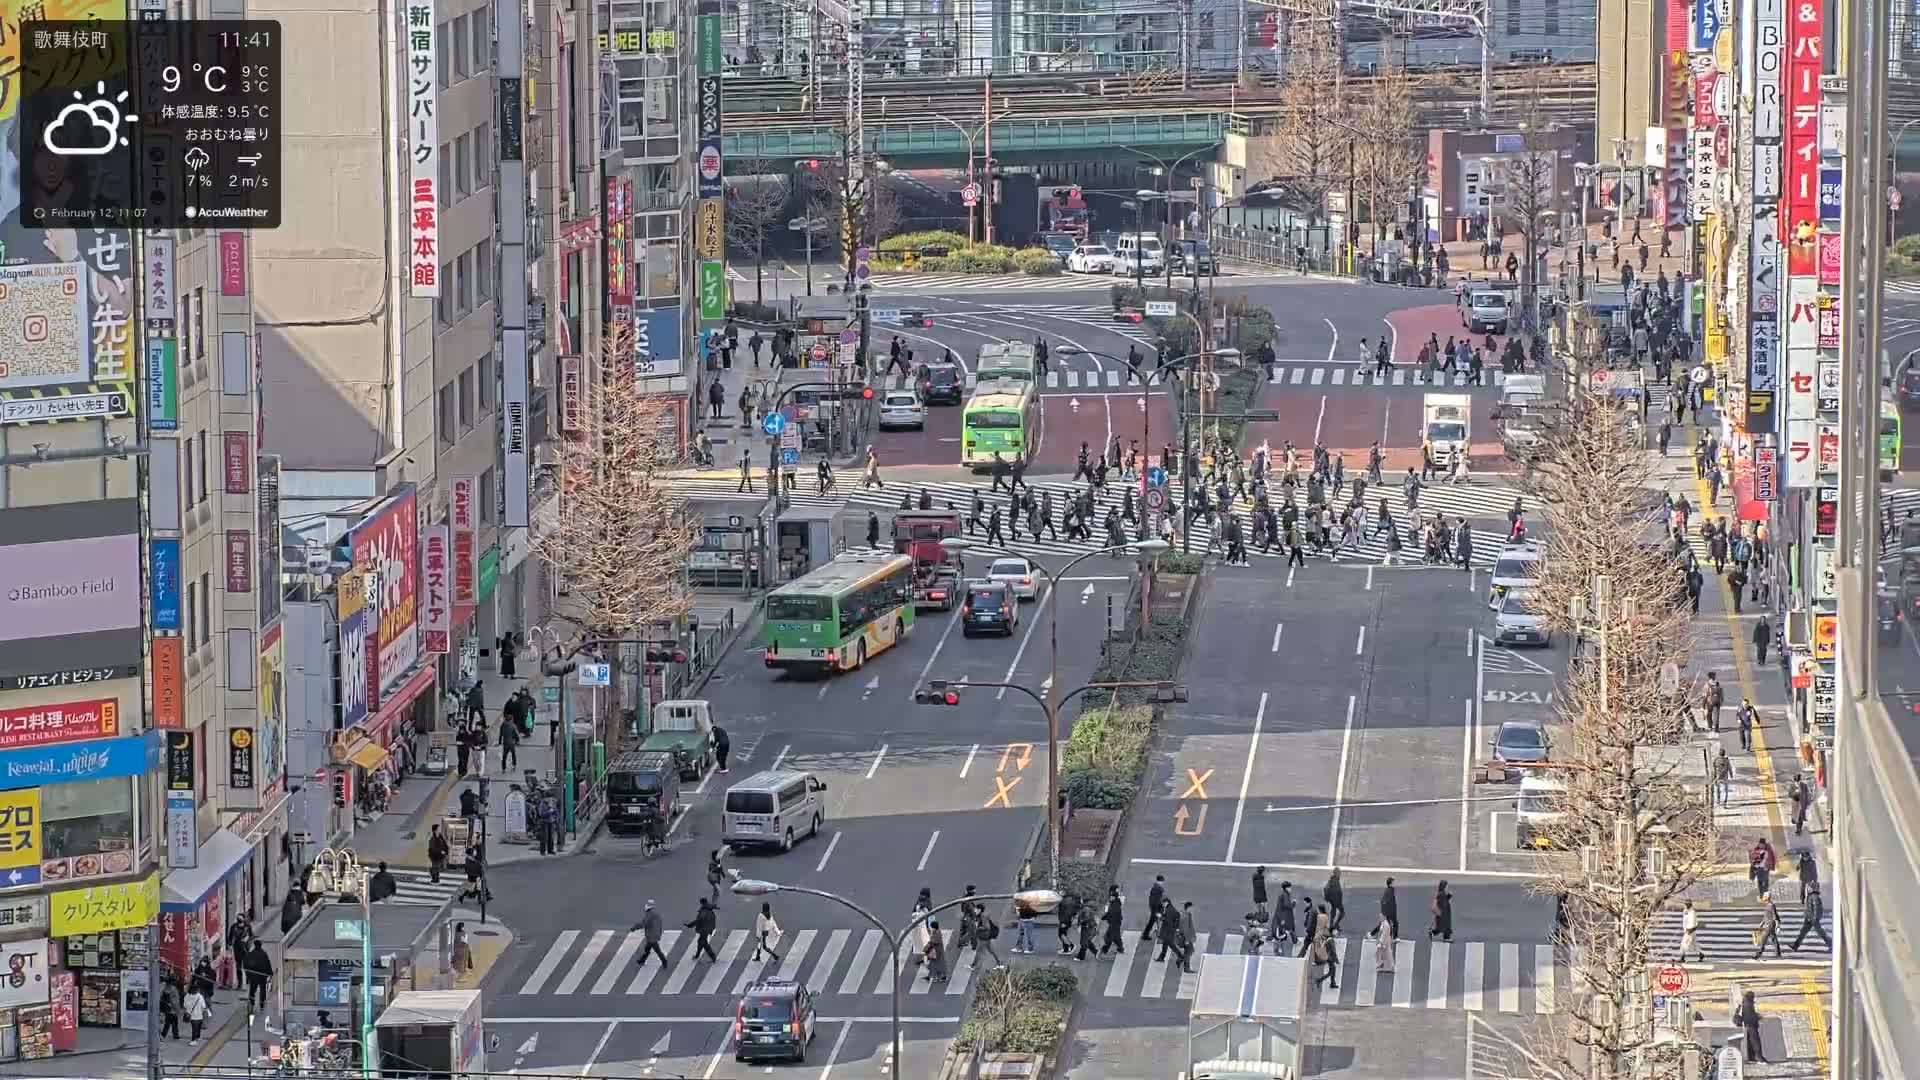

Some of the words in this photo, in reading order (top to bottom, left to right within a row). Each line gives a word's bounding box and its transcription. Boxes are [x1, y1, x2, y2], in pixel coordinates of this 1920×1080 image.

[410, 6, 433, 164] 新宿サンパーク
[1700, 81, 1712, 114] アコム
[412, 179, 436, 287] 三平本館
[704, 202, 719, 256] 肉汁水餃子
[704, 269, 718, 309] レイク
[152, 319, 169, 328] 3F
[1754, 324, 1769, 377] 大衆酒場
[151, 348, 163, 409] FamilyMart
[1790, 302, 1815, 463] パセラ
[8, 402, 43, 416] テンクリ
[47, 399, 105, 414] たいせい先生
[509, 401, 523, 455] HOMEGAME
[22, 585, 78, 600] Bamboo
[82, 577, 115, 594] Field
[427, 537, 444, 624] 三平ストア
[17, 671, 70, 688] リアエイド
[73, 668, 114, 682] ビジョン
[104, 706, 113, 731] 5F
[19, 730, 63, 742] RESTAURANT
[0, 805, 33, 827] プロ
[63, 898, 136, 921] クリスタル
[322, 986, 337, 999] 12
